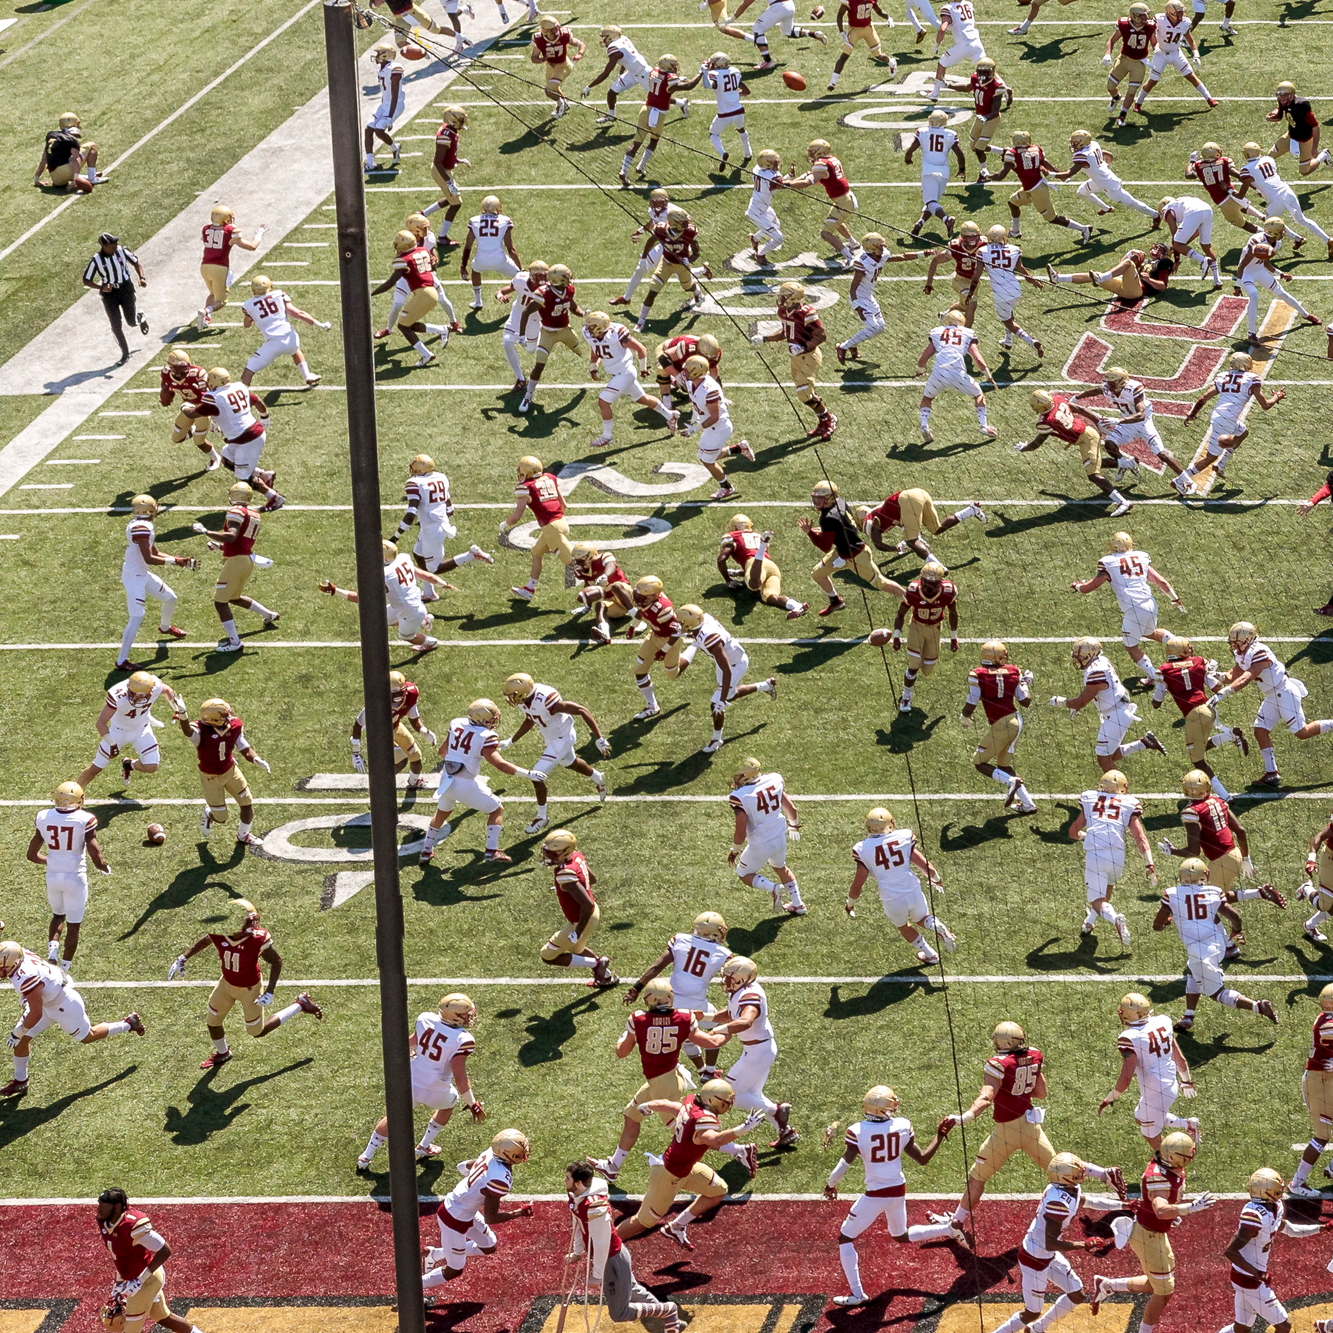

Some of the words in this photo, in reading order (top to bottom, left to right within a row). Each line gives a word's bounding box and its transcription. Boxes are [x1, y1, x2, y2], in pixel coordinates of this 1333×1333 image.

[956, 4, 972, 21] 36
[1128, 34, 1146, 49] 43
[723, 74, 738, 92] 20
[479, 219, 499, 237] 25
[255, 296, 278, 319] 36
[1221, 374, 1243, 393] 25
[228, 390, 247, 414] 99
[428, 481, 445, 503] 29
[1119, 557, 1143, 577] 45
[451, 728, 474, 755] 34
[757, 786, 779, 815] 45
[1092, 795, 1120, 820] 45
[47, 825, 73, 850] 37
[875, 841, 904, 870] 45
[1185, 894, 1207, 920] 16
[224, 951, 239, 972] 11
[683, 946, 710, 977] 16
[419, 1028, 448, 1061] 45
[646, 1026, 678, 1054] 85
[1148, 1027, 1170, 1058] 45
[1011, 1063, 1038, 1095] 85
[871, 1132, 900, 1163] 20
